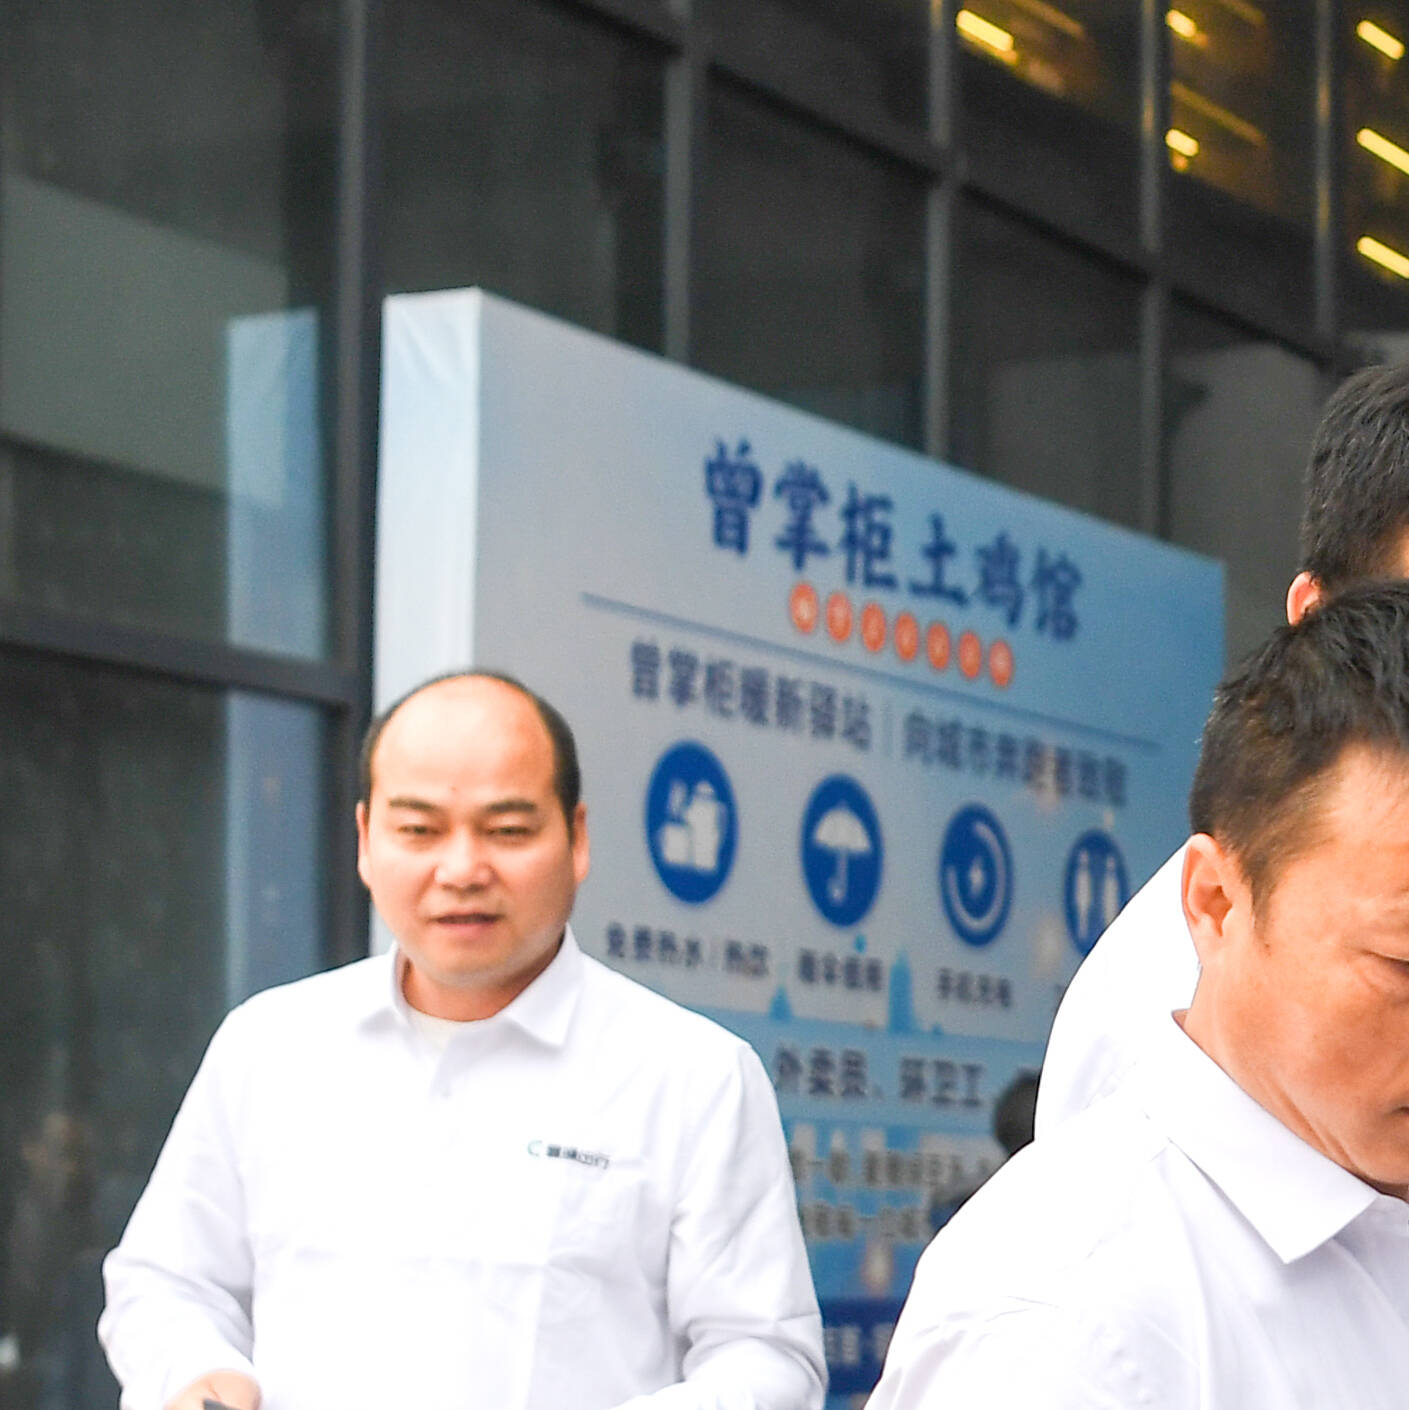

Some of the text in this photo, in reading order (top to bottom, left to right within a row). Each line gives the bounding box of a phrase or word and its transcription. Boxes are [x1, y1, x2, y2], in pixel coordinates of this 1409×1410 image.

[703, 437, 1083, 641] 曾掌柜土鸡馆
